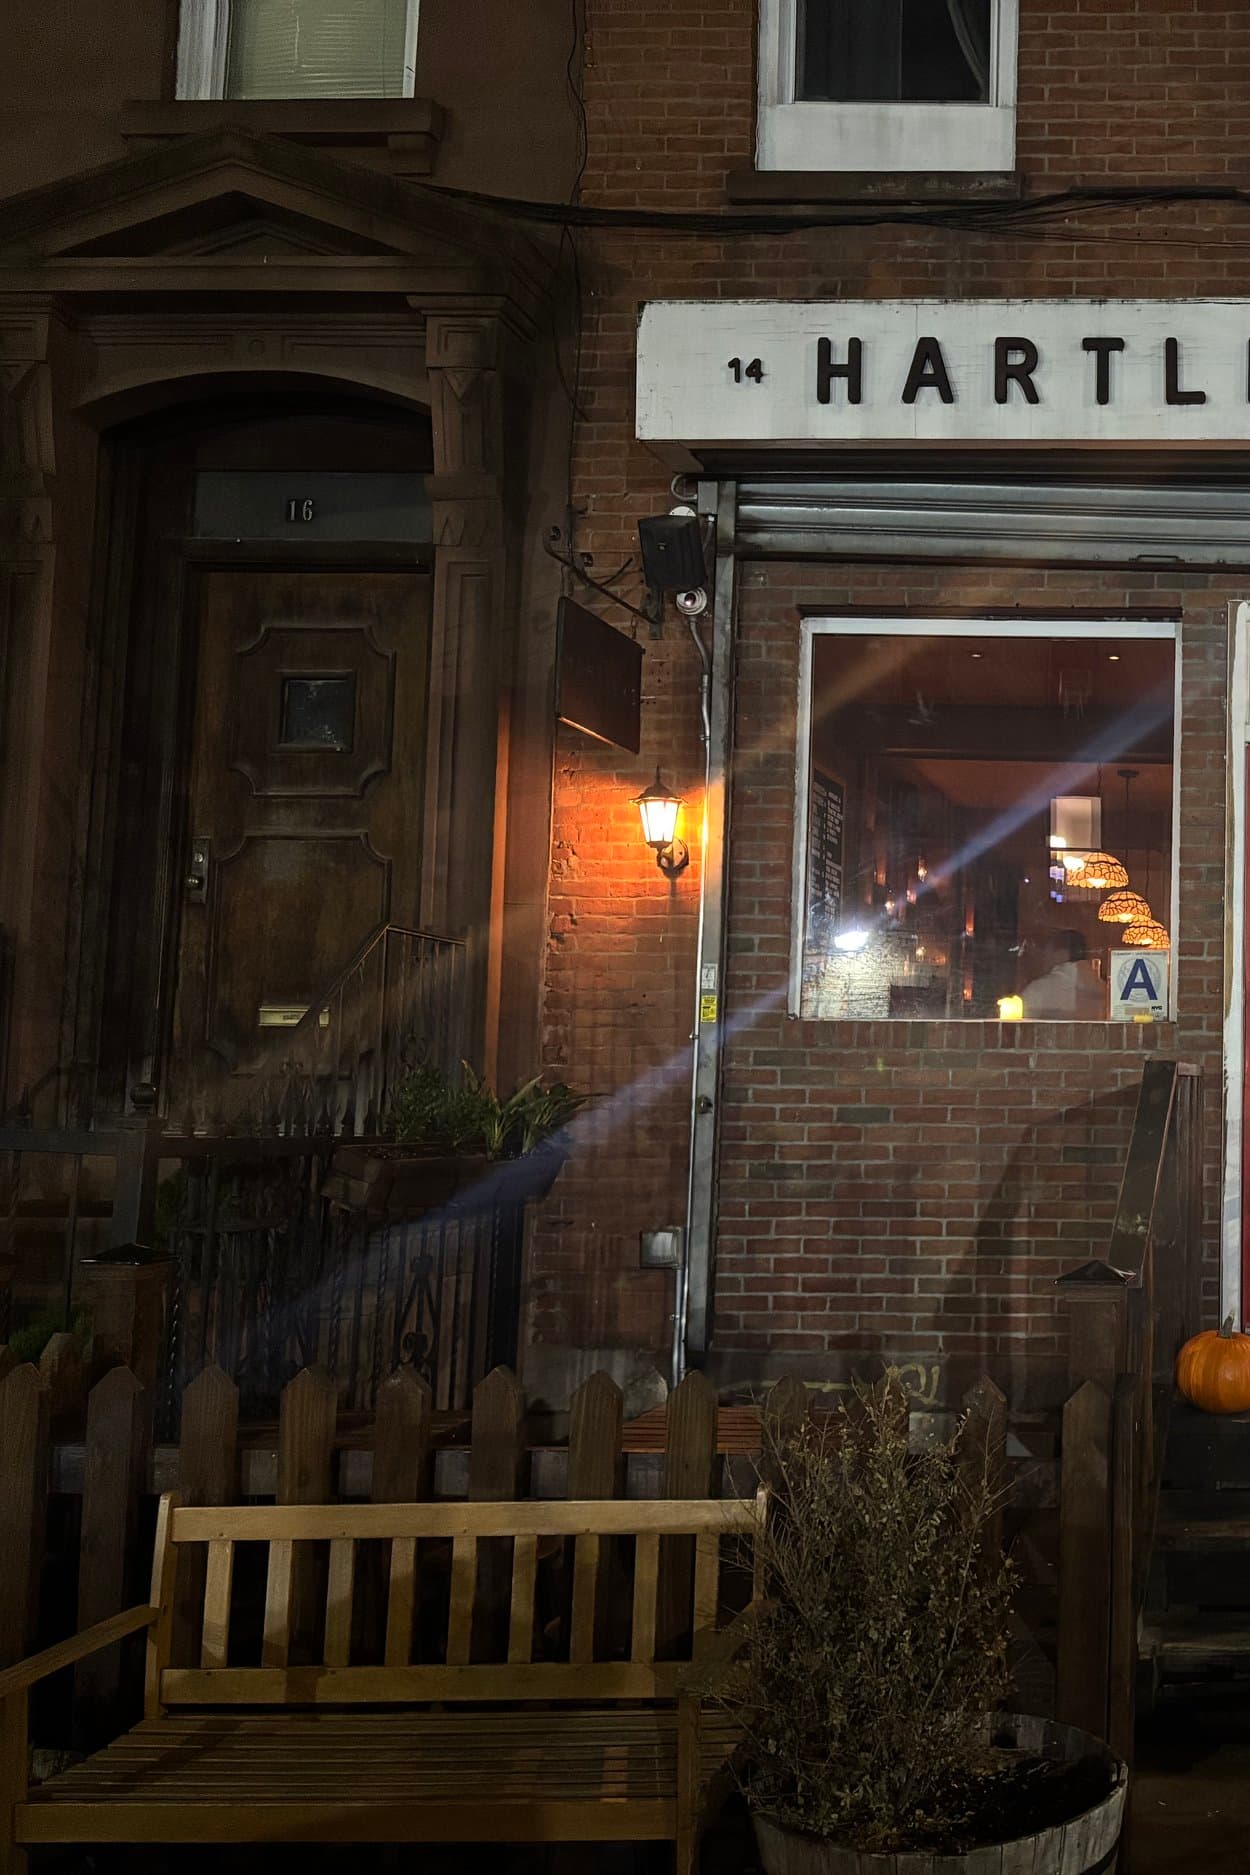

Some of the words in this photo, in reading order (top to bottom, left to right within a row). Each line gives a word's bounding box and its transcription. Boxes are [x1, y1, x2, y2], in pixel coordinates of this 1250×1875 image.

[728, 358, 764, 384] 14
[288, 499, 314, 522] 16
[1120, 958, 1158, 1001] A
